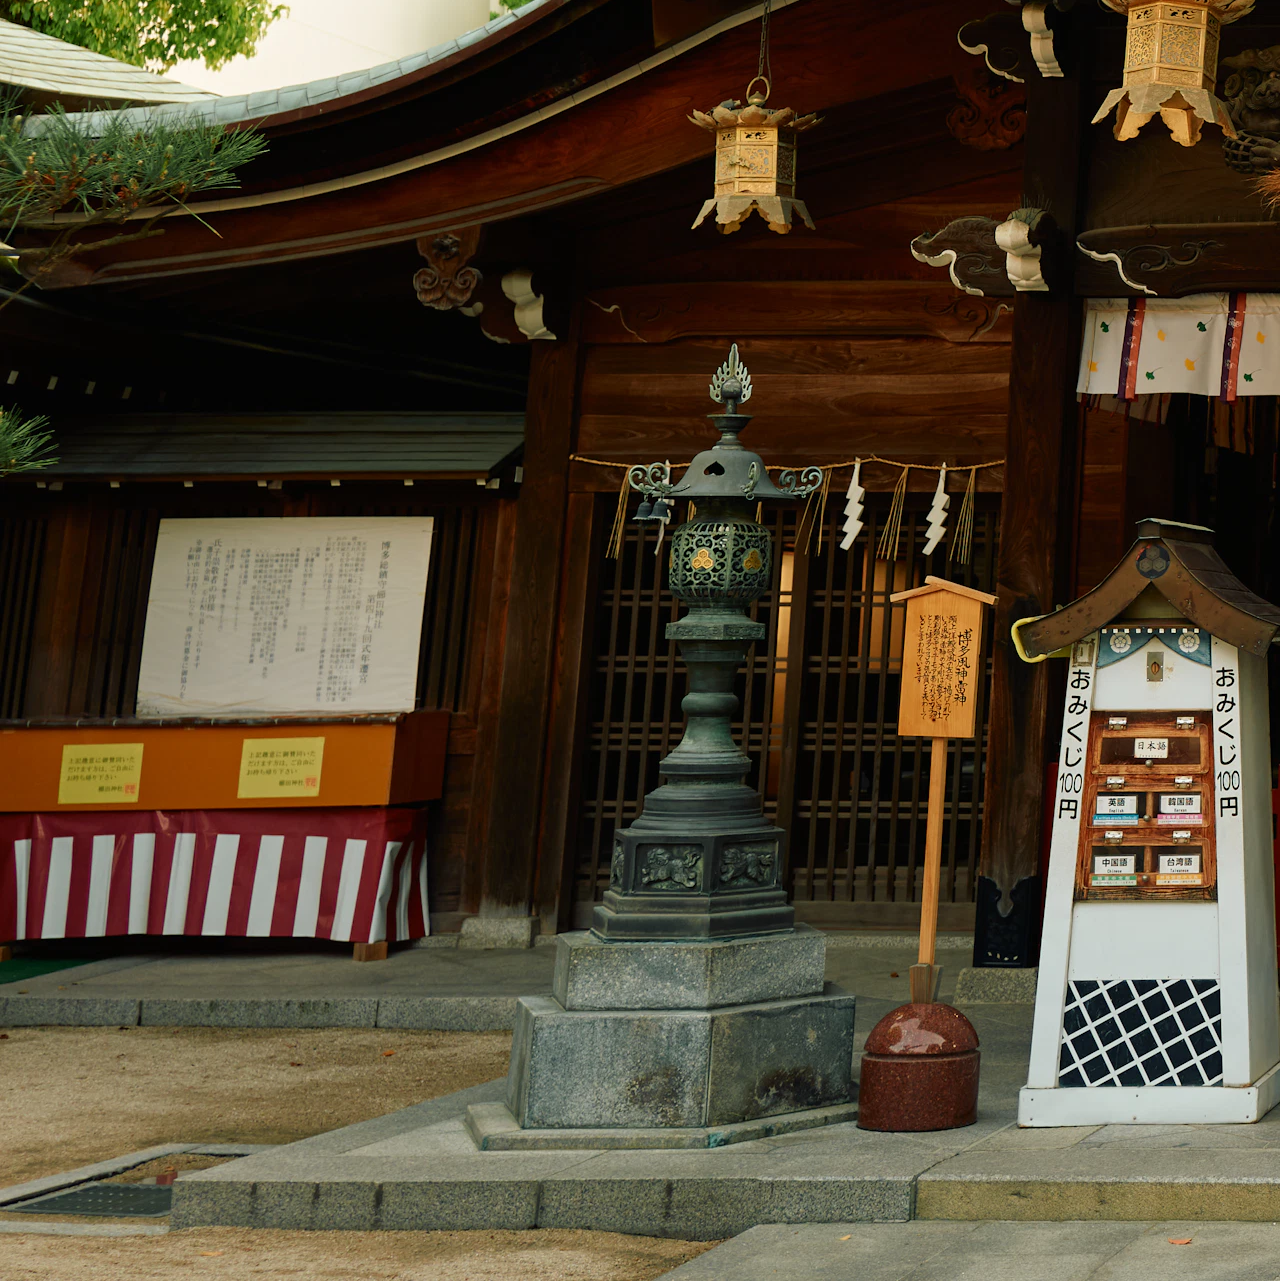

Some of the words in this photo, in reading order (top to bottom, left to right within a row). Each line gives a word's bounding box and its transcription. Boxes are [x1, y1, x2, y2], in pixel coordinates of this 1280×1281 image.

[1057, 668, 1091, 821] おみくじ100円
[1138, 741, 1167, 751] 日本語
[1214, 667, 1240, 818] おみくじ100円
[1108, 798, 1125, 806] 英語
[1168, 797, 1194, 806] 韓国語
[1102, 858, 1127, 867] 中国語
[1167, 858, 1192, 867] 台湾語
